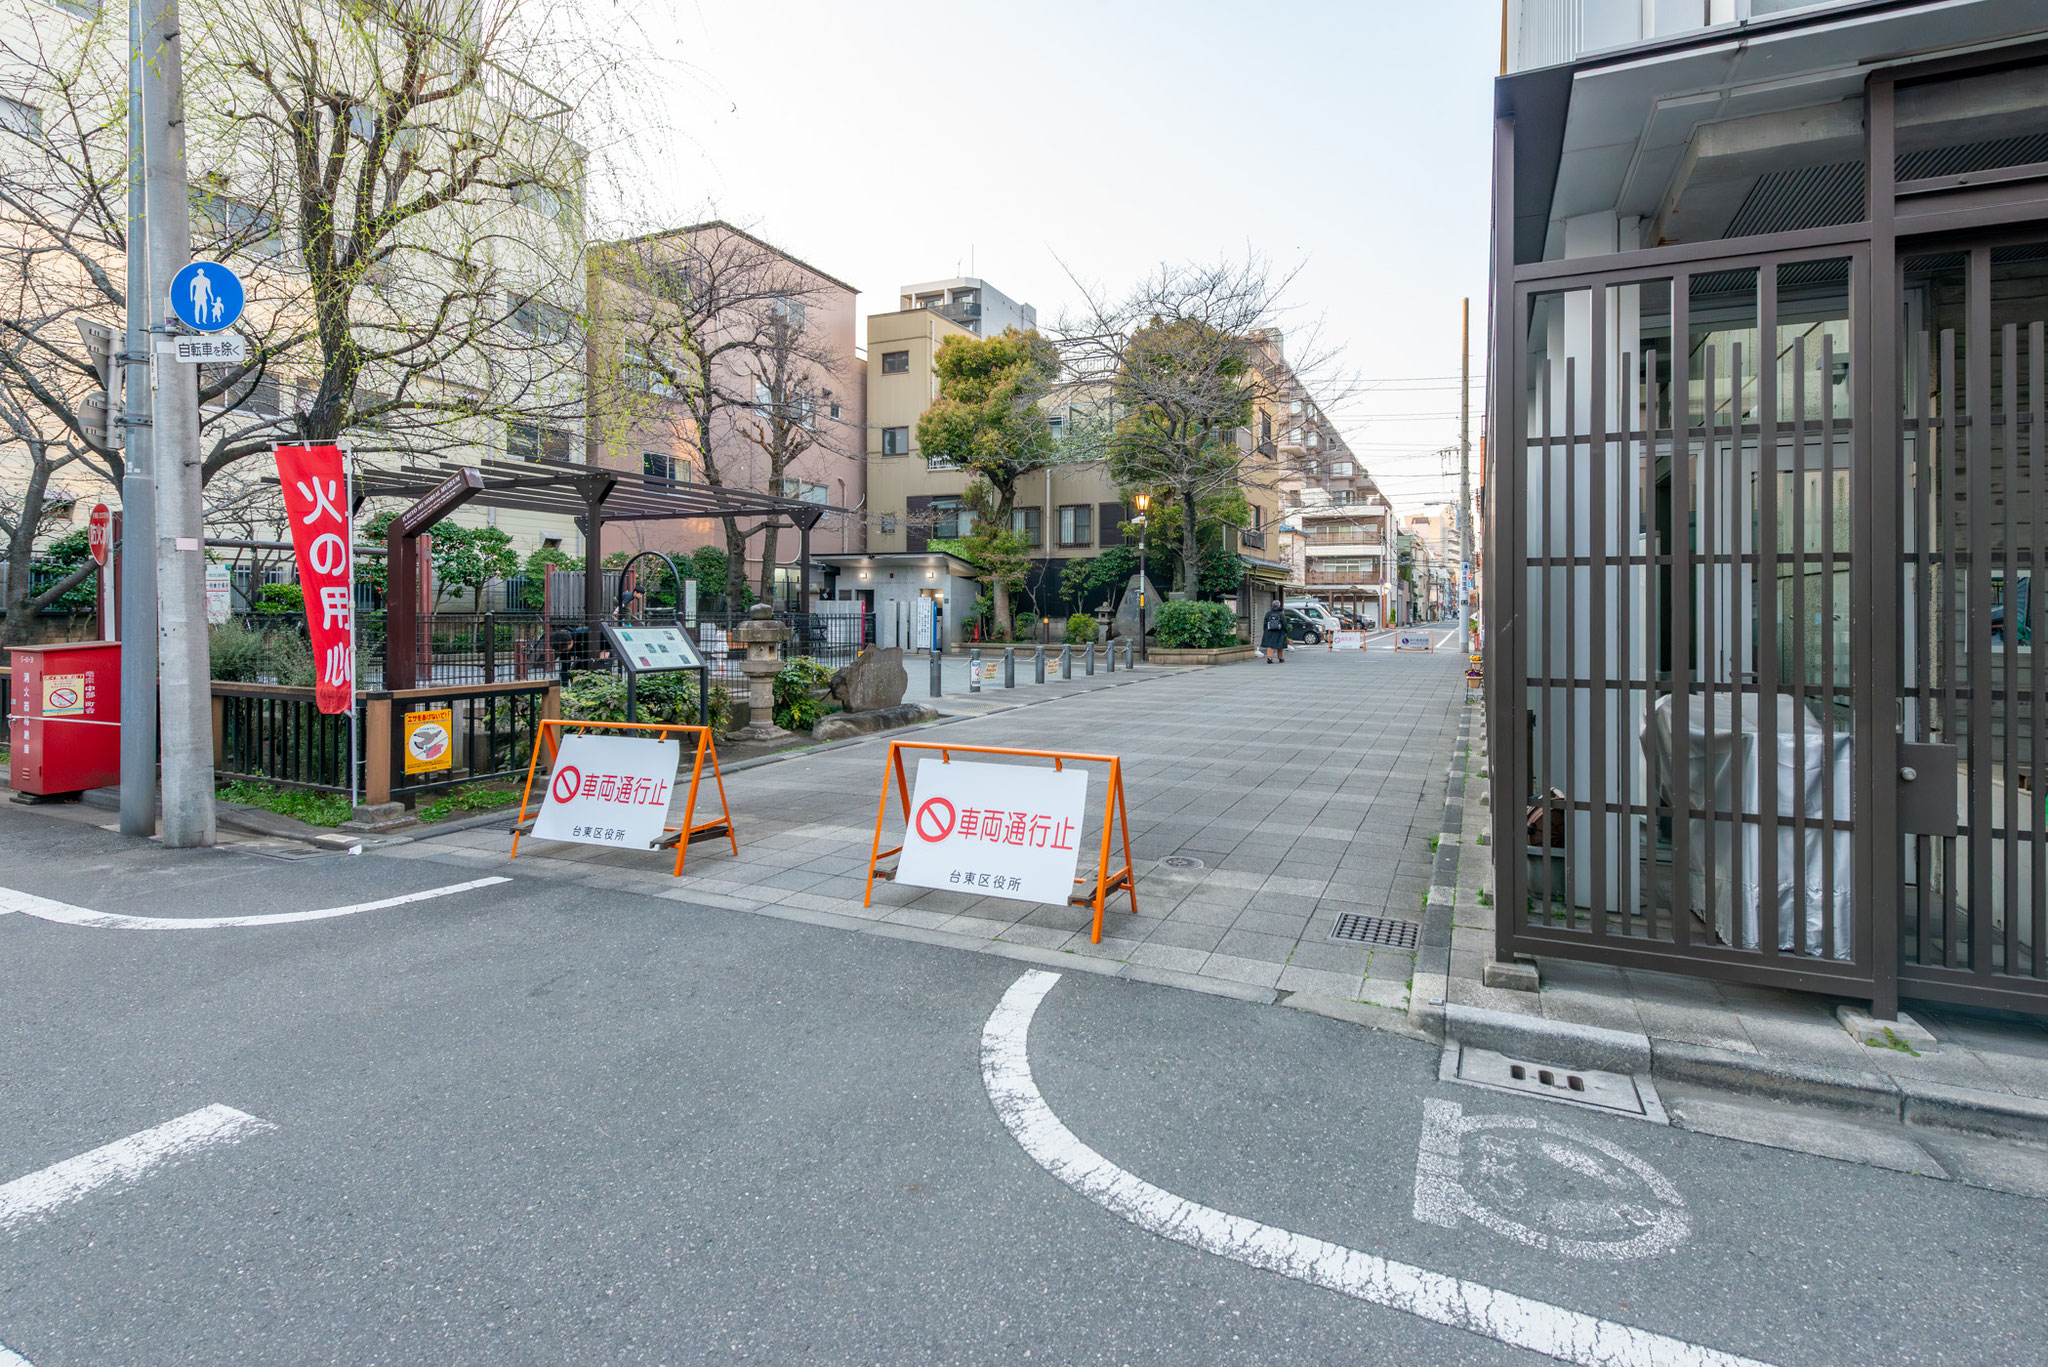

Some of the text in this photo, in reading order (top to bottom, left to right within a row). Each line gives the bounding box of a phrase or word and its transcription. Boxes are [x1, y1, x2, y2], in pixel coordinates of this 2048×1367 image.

[178, 341, 240, 357] 自転車を除く
[417, 490, 441, 510] MEMORIAL
[440, 475, 460, 493] MUSEUM
[297, 476, 350, 686] 火の用心
[580, 773, 667, 806] 車両通行止
[572, 825, 626, 841] 台東区役所
[957, 807, 1075, 850] 車両通行止
[949, 869, 1022, 892] 台東区役所
